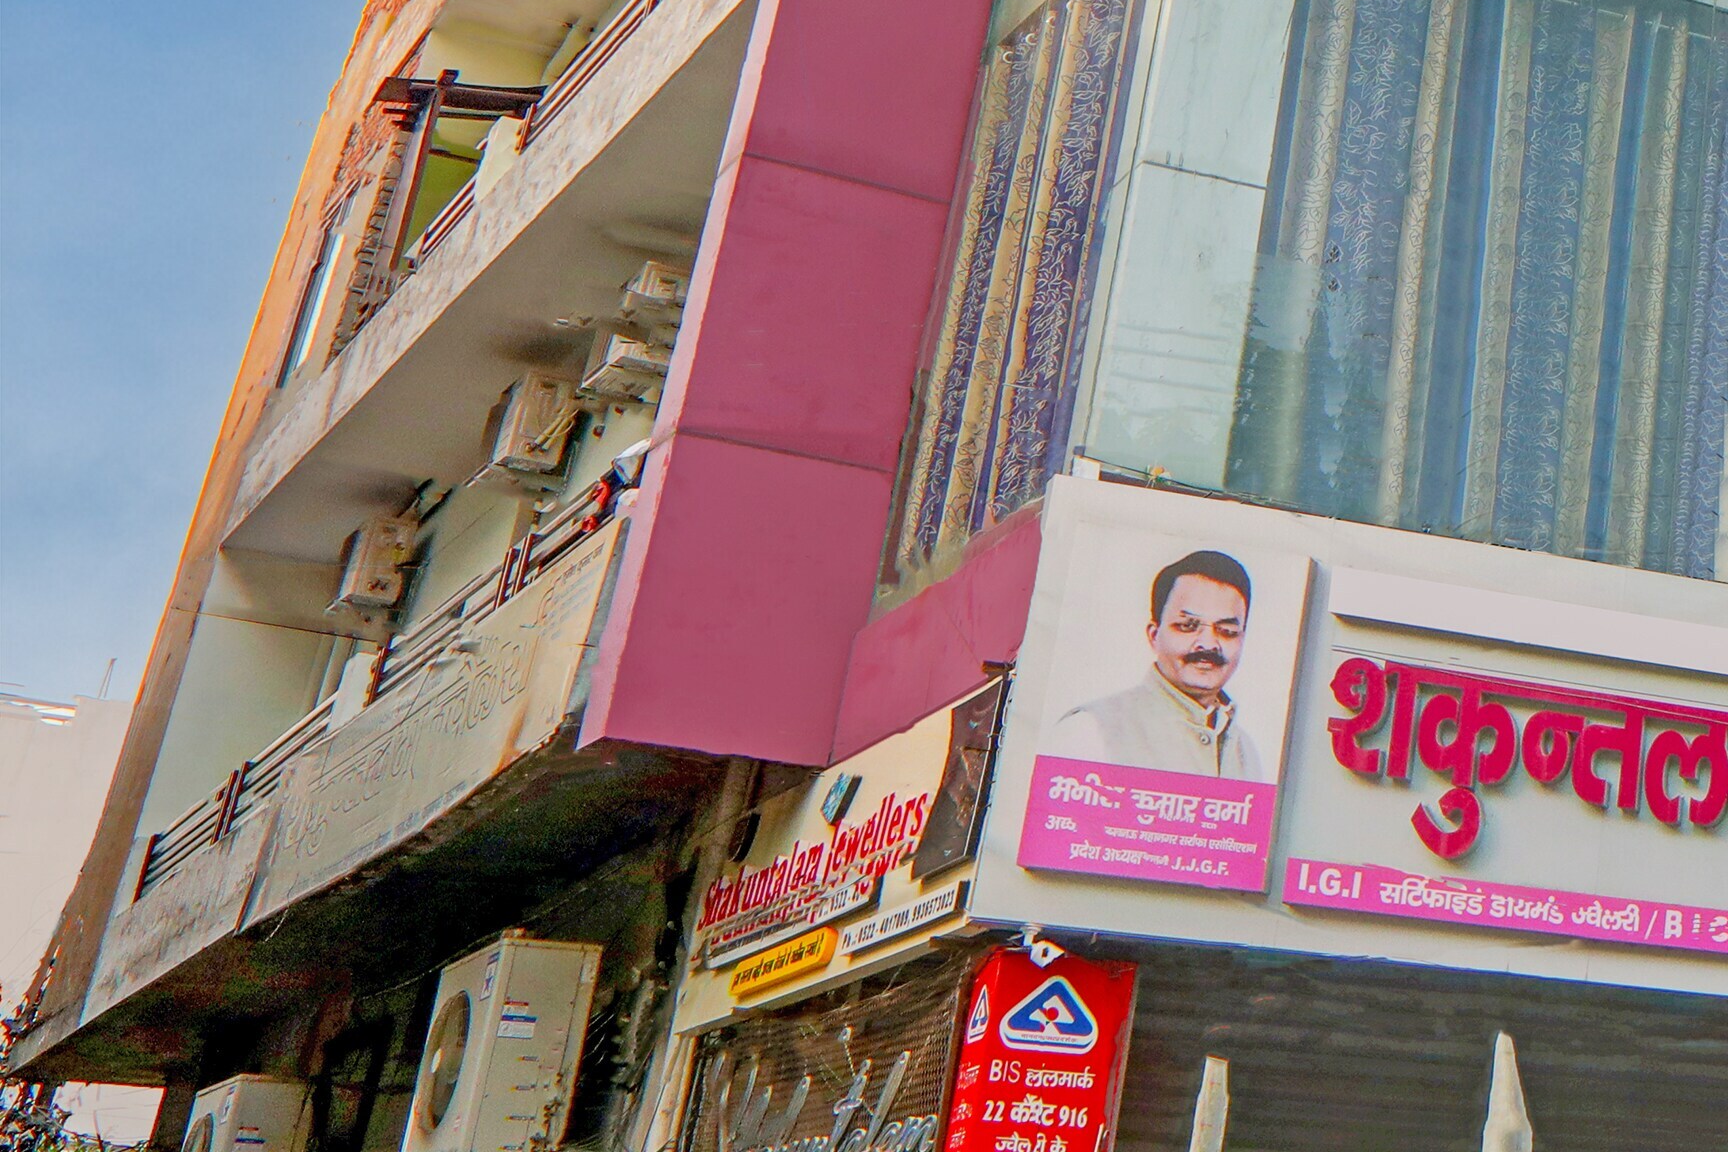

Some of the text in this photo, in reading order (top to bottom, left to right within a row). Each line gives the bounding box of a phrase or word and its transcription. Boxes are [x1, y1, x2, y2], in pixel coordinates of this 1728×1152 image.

[1203, 794, 1254, 825] वर्मा
[989, 1058, 1021, 1084] BIS
[982, 1099, 1006, 1122] 22
[1058, 1105, 1089, 1129] 916
